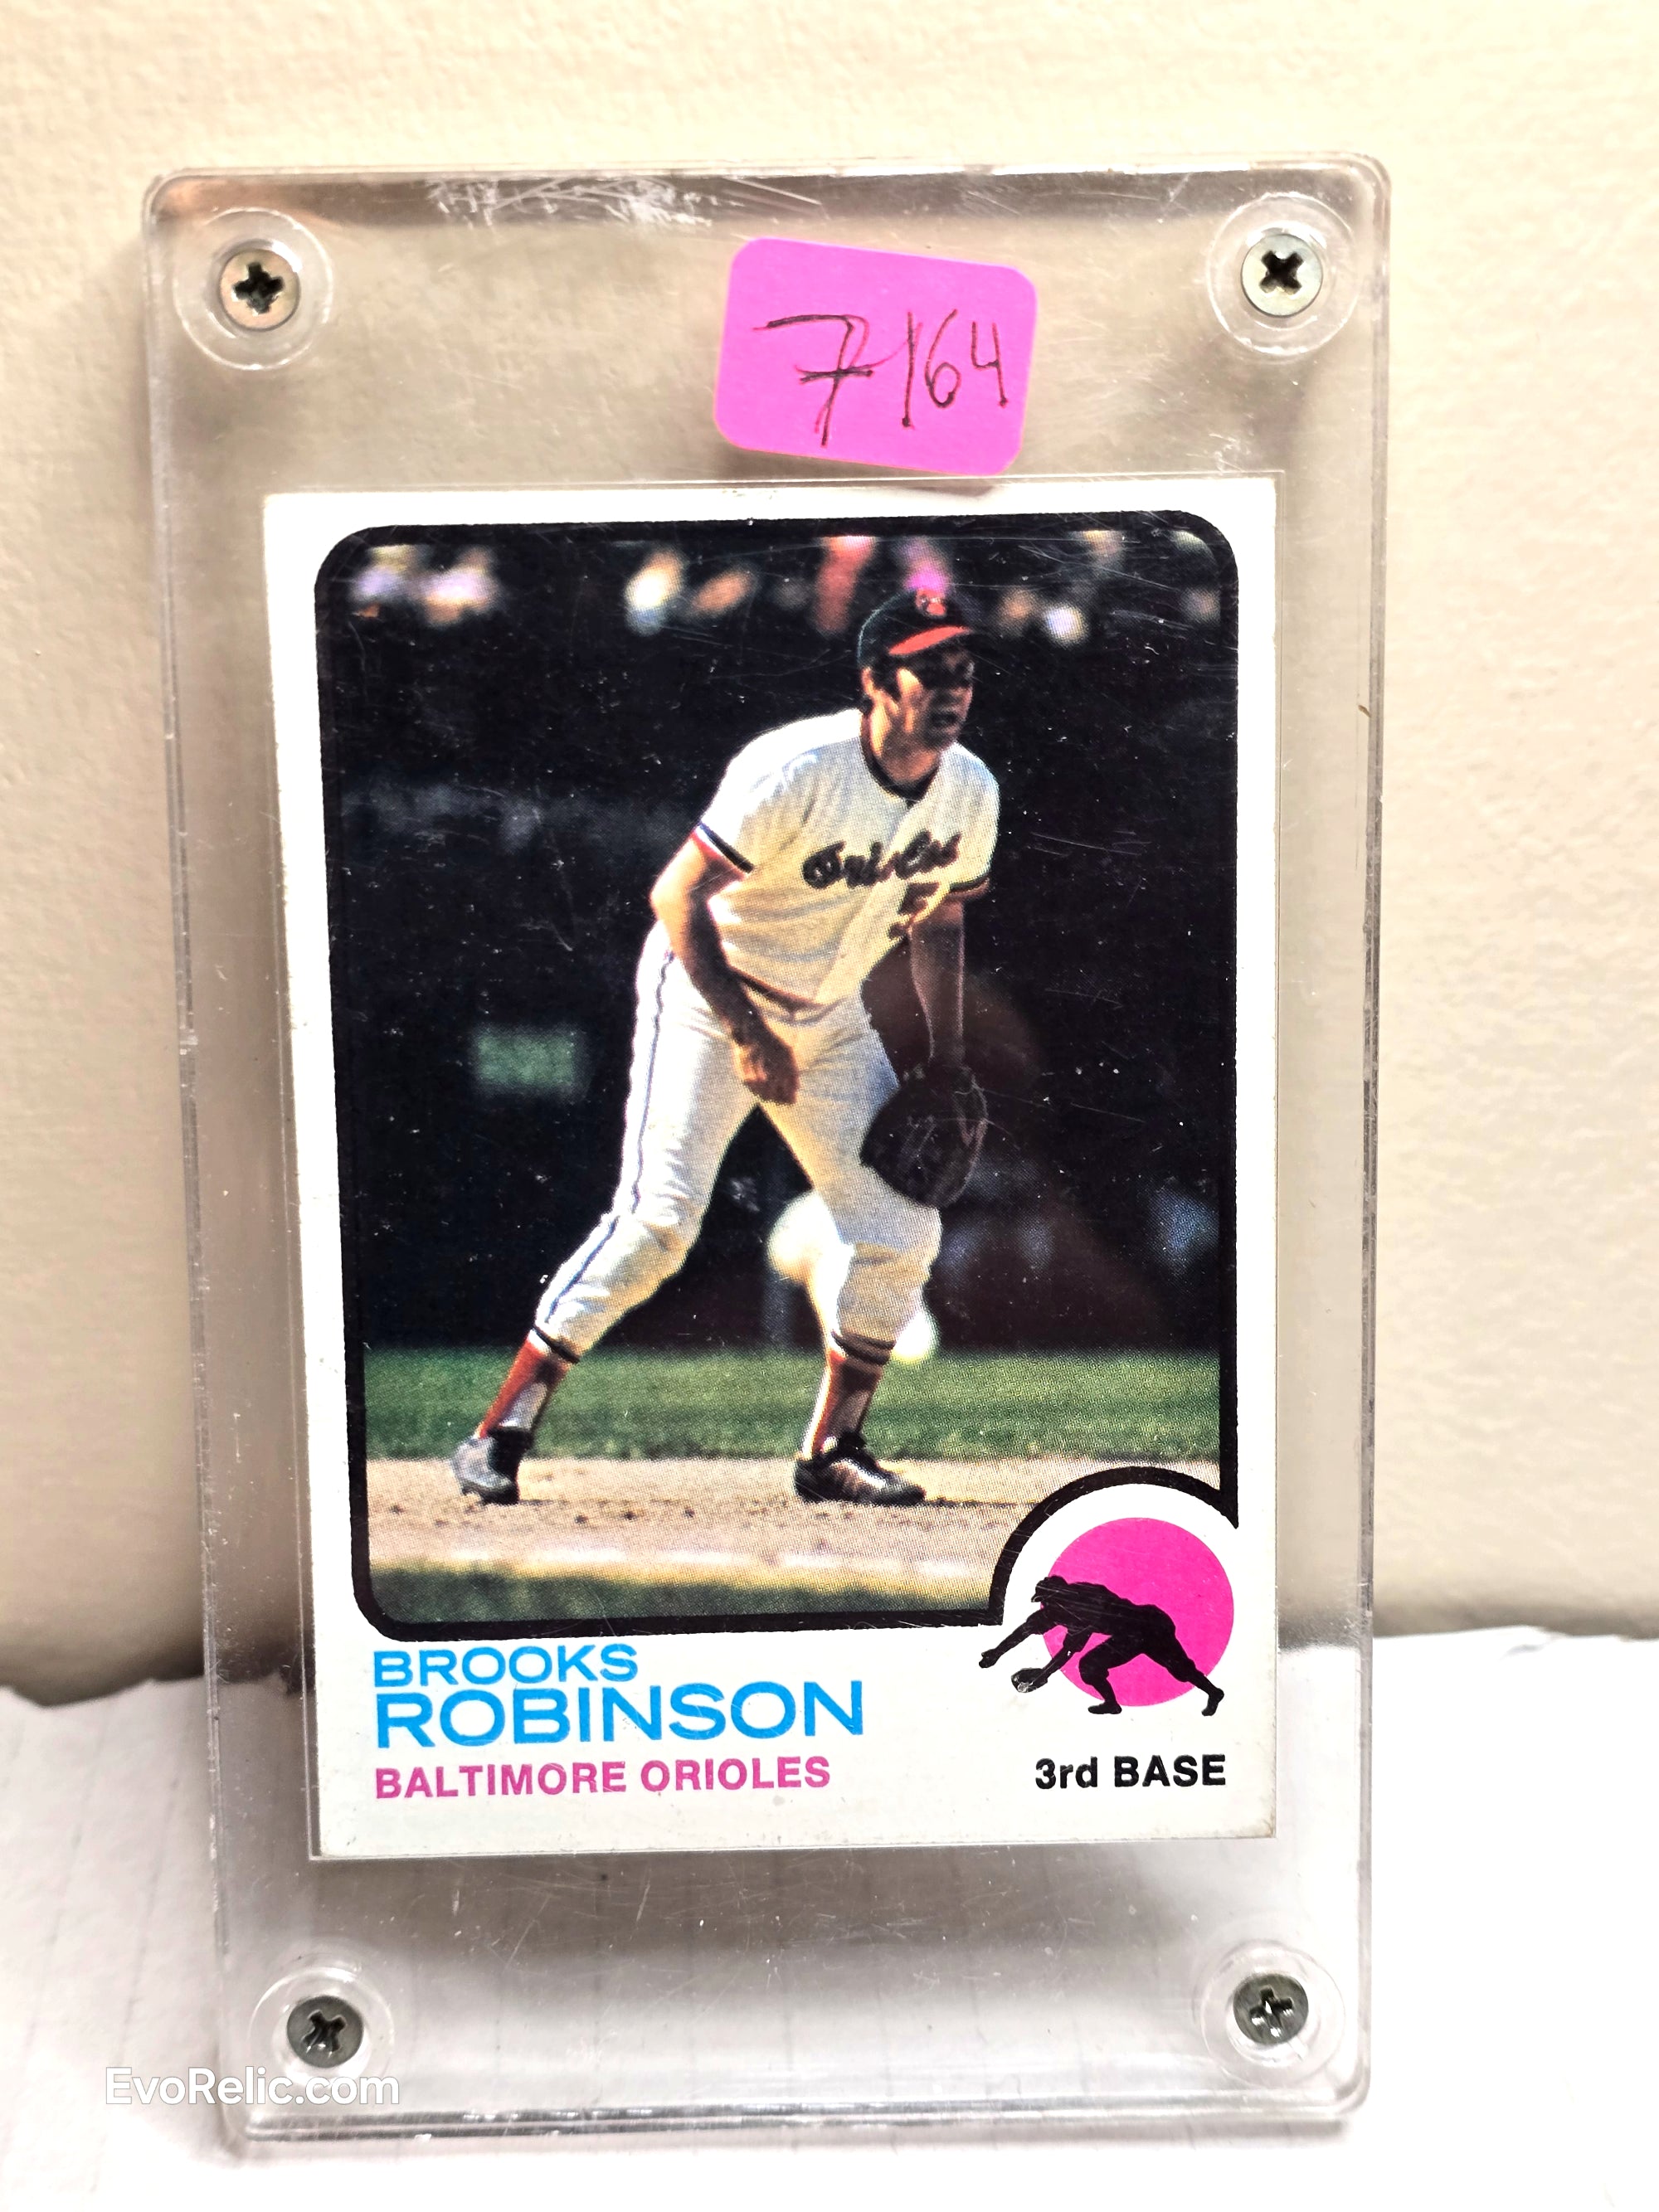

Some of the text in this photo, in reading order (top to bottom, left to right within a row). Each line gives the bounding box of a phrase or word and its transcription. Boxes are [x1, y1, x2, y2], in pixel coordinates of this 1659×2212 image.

[373, 1643, 638, 1687] BROOKS
[377, 1680, 864, 1748] ROBINSON
[376, 1756, 830, 1799] BALTIMORE ORIOLES
[1035, 1754, 1226, 1789] 3rd BASE
